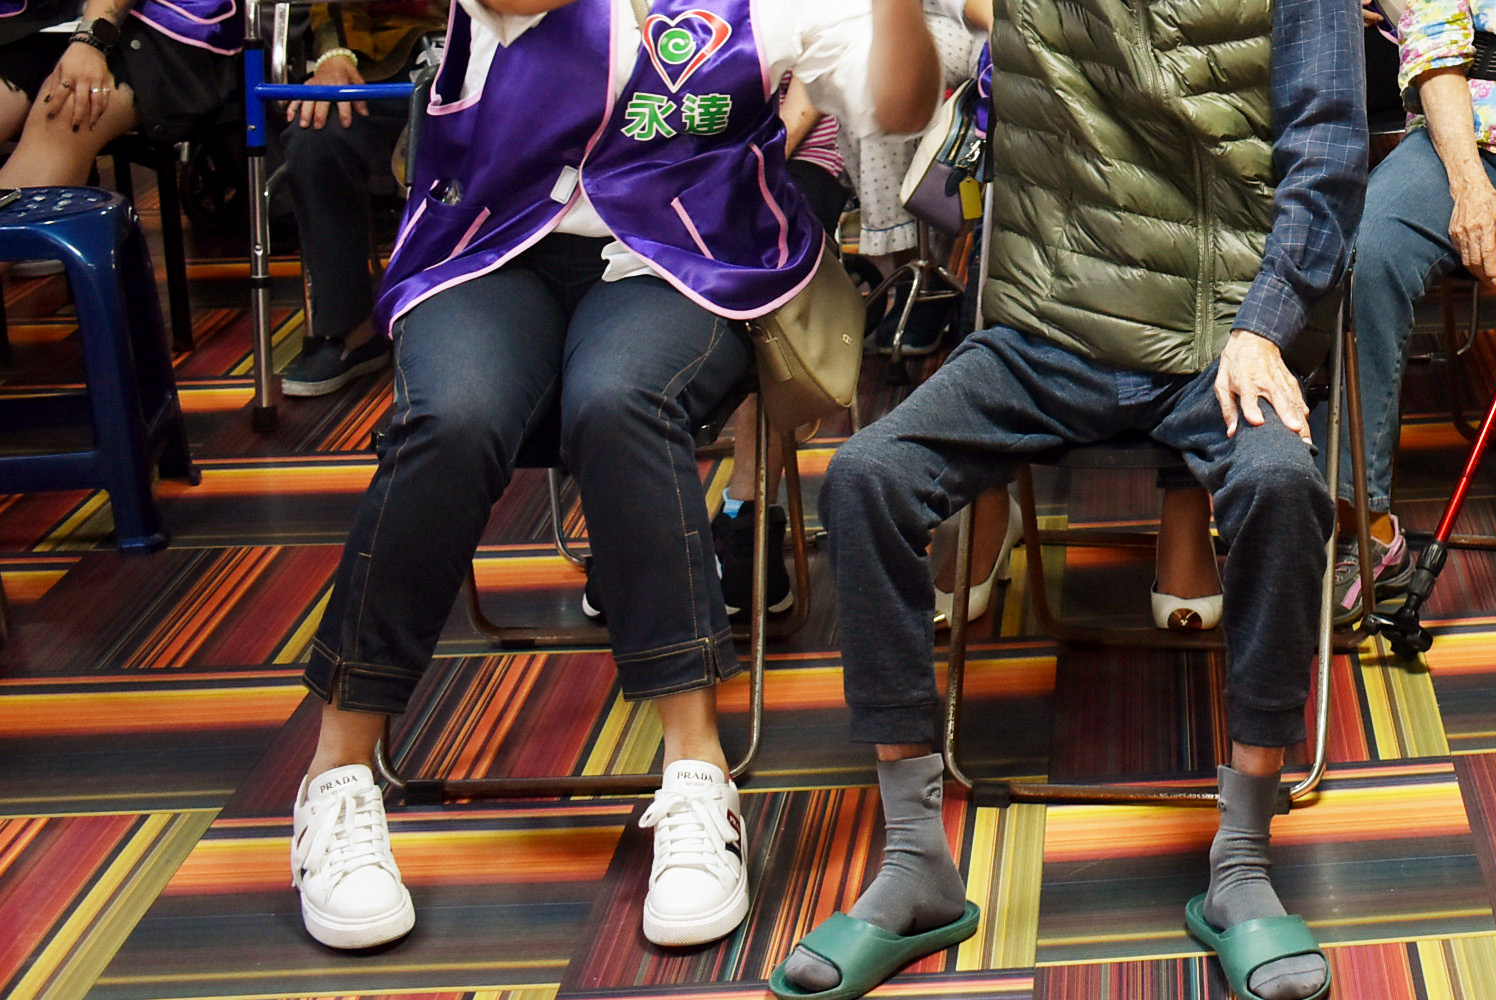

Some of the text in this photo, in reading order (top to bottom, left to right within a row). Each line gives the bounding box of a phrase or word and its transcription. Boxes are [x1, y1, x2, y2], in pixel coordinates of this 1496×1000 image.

[621, 92, 732, 141] 永達
[320, 775, 358, 793] PRADA
[676, 771, 713, 783] PRADA
